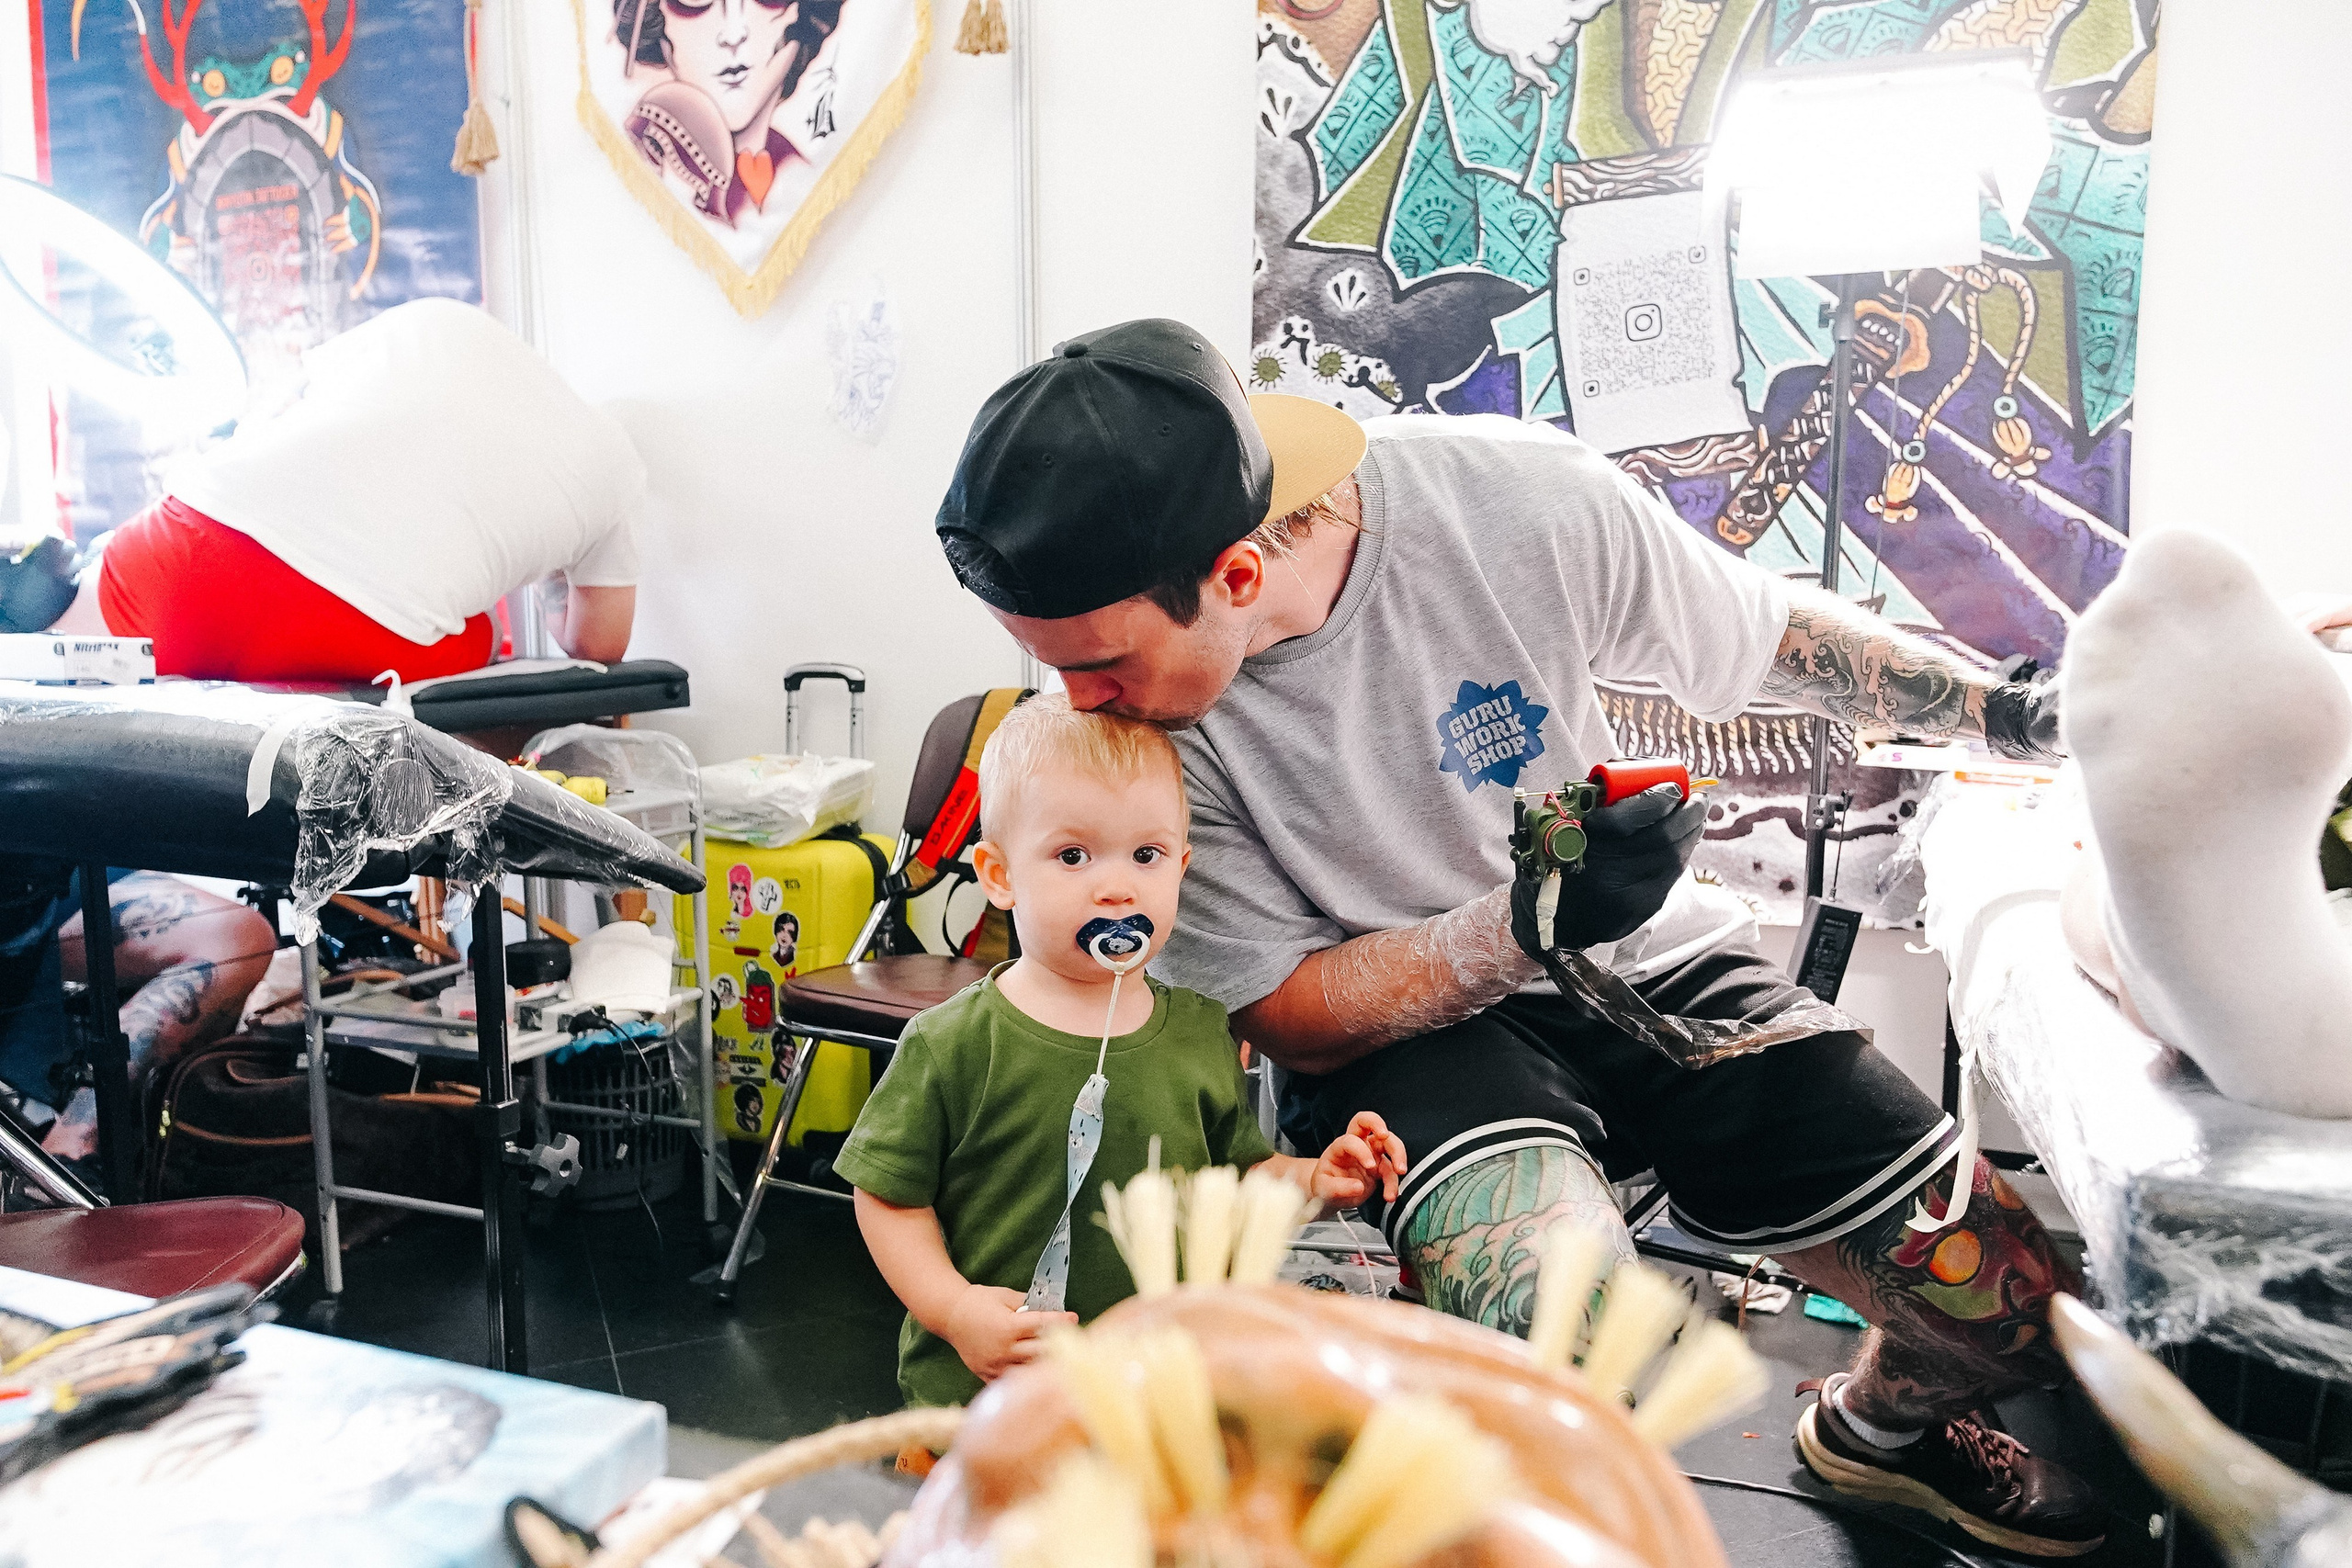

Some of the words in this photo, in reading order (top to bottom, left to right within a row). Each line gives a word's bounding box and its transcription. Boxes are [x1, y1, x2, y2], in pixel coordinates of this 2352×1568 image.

[1449, 695, 1511, 739] GURU
[1454, 713, 1525, 759] WORK
[1467, 735, 1526, 775] SHOP
